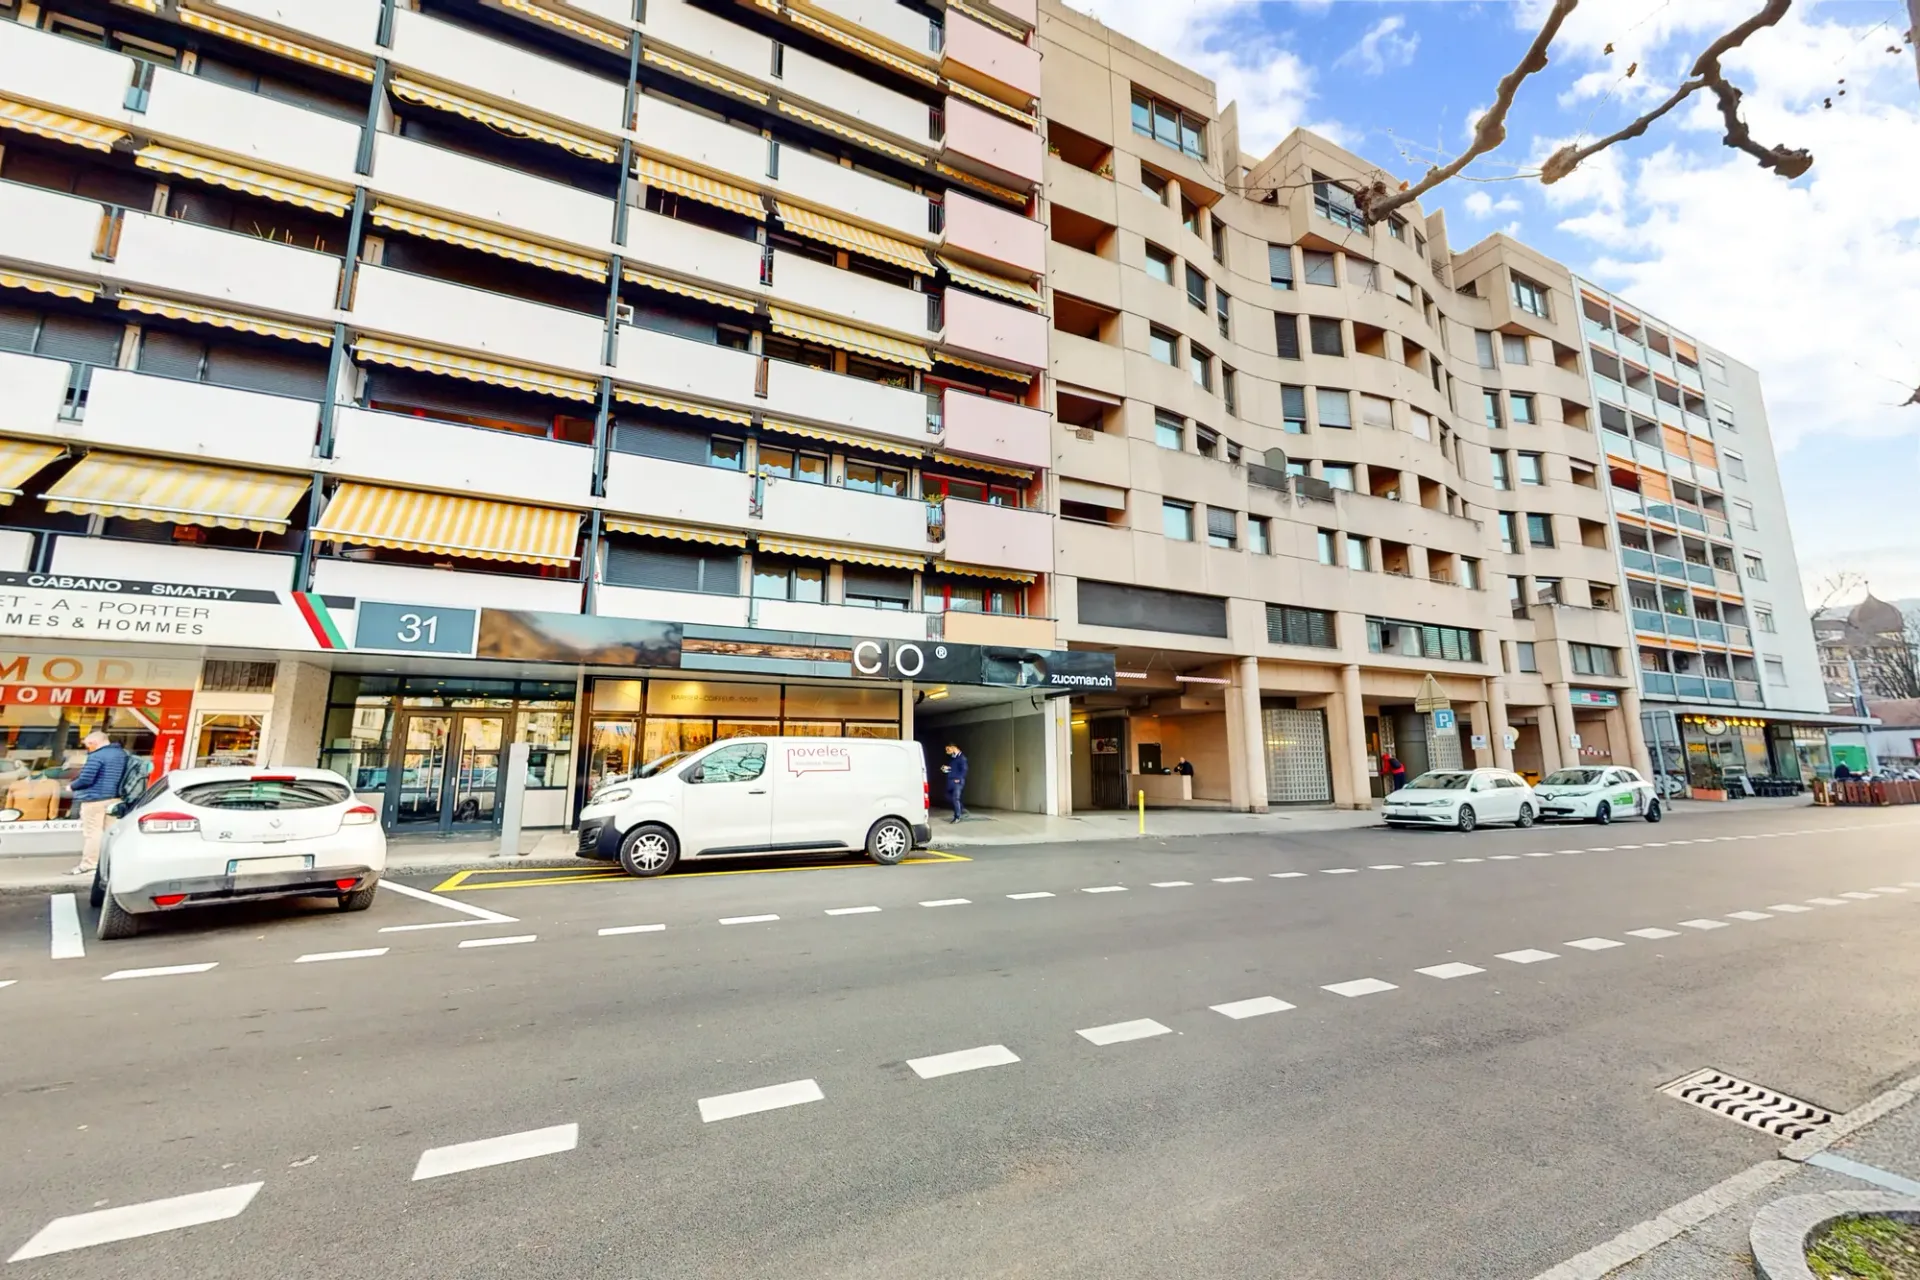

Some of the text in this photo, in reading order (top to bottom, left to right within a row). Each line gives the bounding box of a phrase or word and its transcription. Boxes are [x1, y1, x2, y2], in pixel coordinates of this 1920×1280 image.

[27, 575, 122, 592] CABANO
[151, 584, 237, 599] SMARTY
[52, 599, 70, 611] A
[99, 601, 210, 619] PORTER
[5, 613, 204, 635] MES & HOMMES
[397, 613, 437, 644] 31
[853, 641, 924, 676] CO
[1051, 673, 1112, 687] zucoman.ch
[1439, 713, 1449, 727] P
[787, 745, 848, 757] novelec
